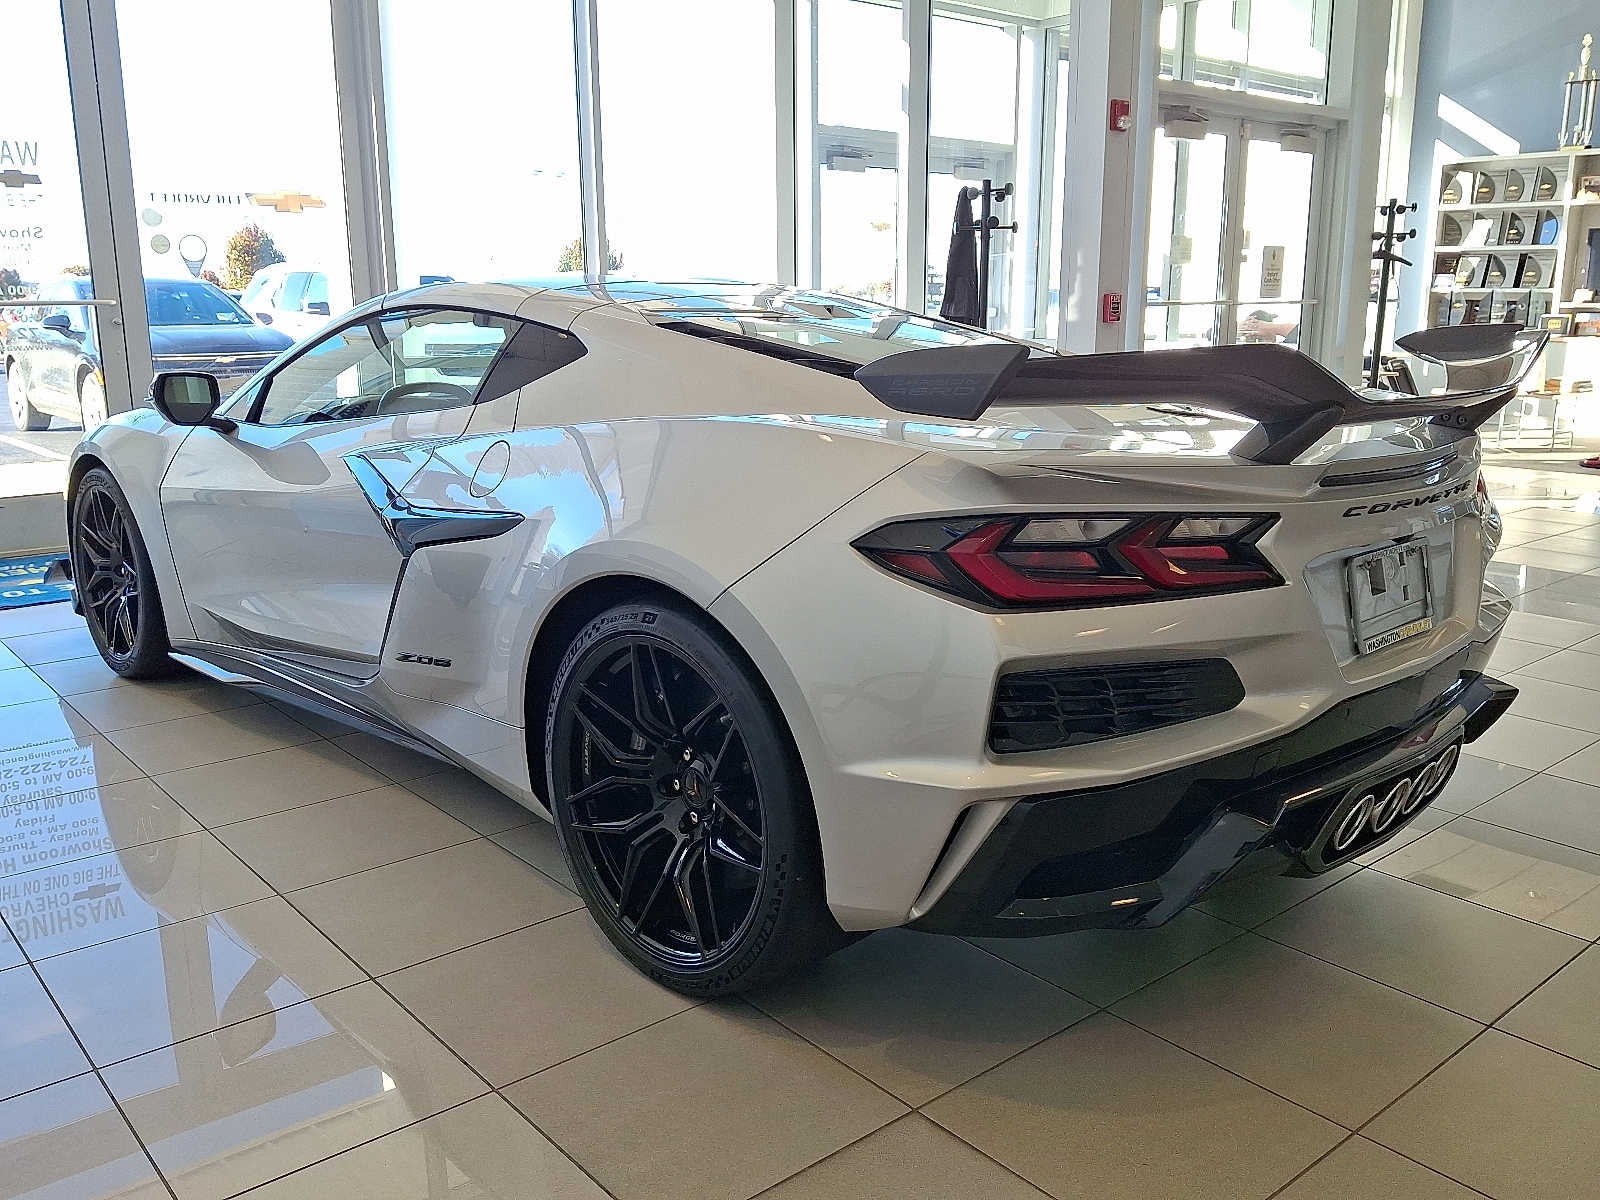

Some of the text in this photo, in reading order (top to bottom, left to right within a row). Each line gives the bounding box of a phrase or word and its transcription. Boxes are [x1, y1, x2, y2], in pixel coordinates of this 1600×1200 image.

[1342, 480, 1471, 518] CORVETTE
[1366, 630, 1401, 653] WASHINGTON
[395, 651, 452, 668] Z06
[0, 755, 90, 779] 724-222-2
[24, 777, 38, 786] to
[42, 771, 63, 785] AM
[3, 785, 63, 806] Saturday
[44, 796, 64, 811] AM
[15, 814, 55, 828] Friday
[48, 824, 67, 834] AM
[49, 826, 99, 843] Monday
[22, 836, 114, 865] Showroom
[73, 868, 93, 885] BIG
[97, 863, 121, 880] THE
[23, 880, 40, 897] ON
[44, 874, 69, 892] ONE
